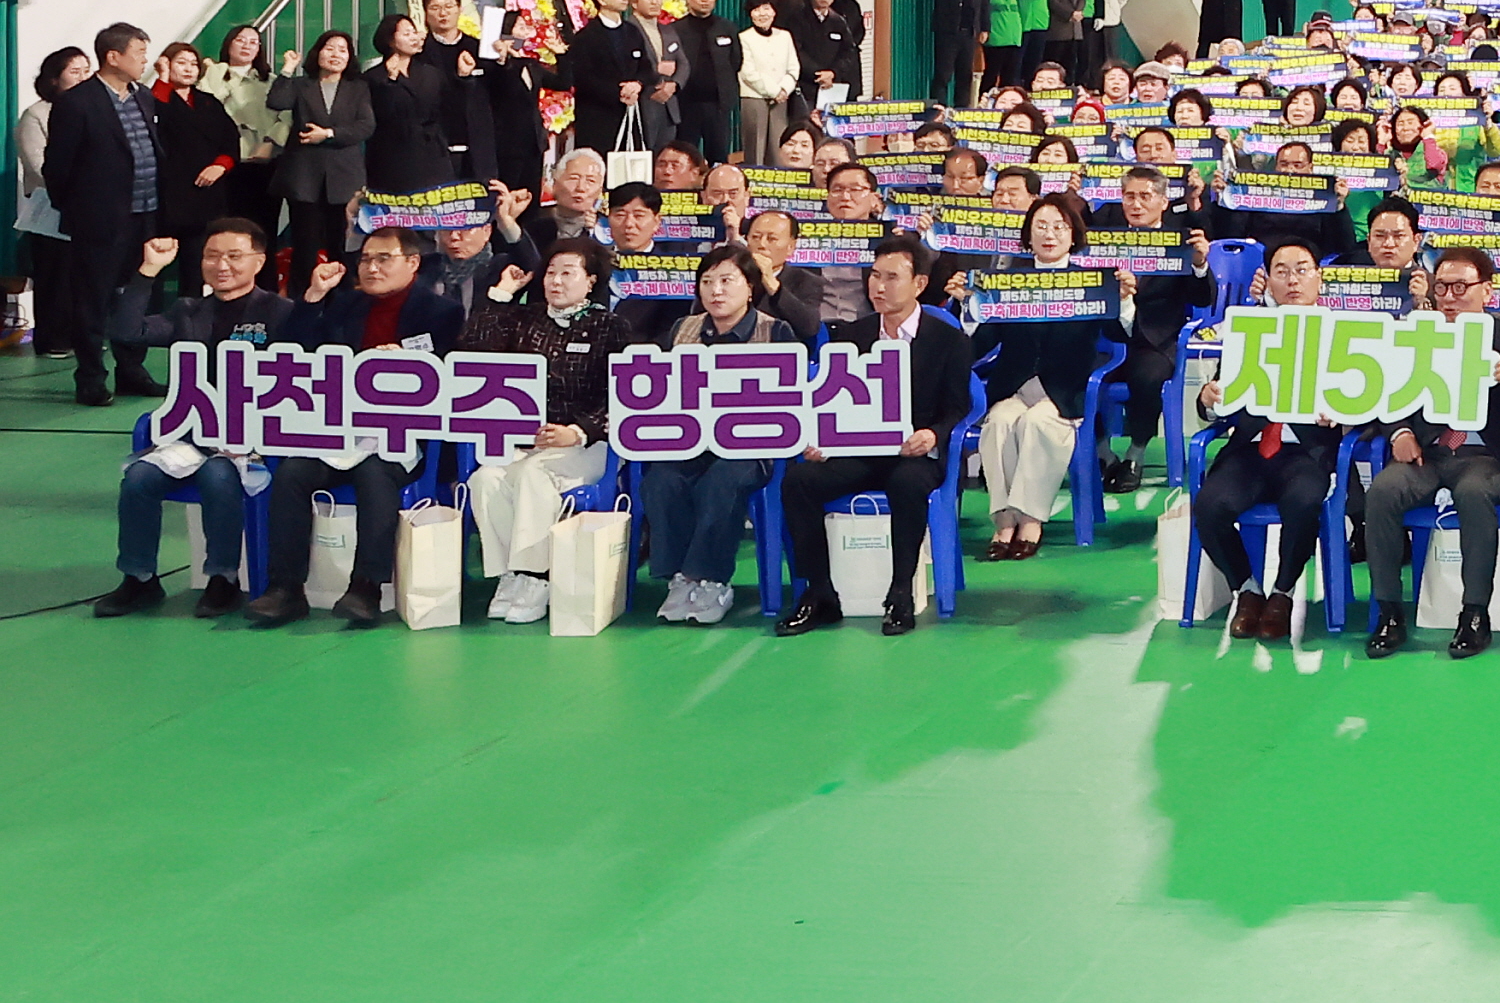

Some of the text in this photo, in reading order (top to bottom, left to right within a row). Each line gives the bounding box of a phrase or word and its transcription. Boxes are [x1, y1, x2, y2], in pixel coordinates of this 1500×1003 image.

[983, 272, 1103, 289] 사천우주항공철도!
[1000, 289, 1086, 302] 제5차 국가철도망
[980, 300, 1106, 318] 구축계획에 반영하라!
[1222, 310, 1492, 424] 제5차
[158, 344, 907, 460] 사천우주 항공선
